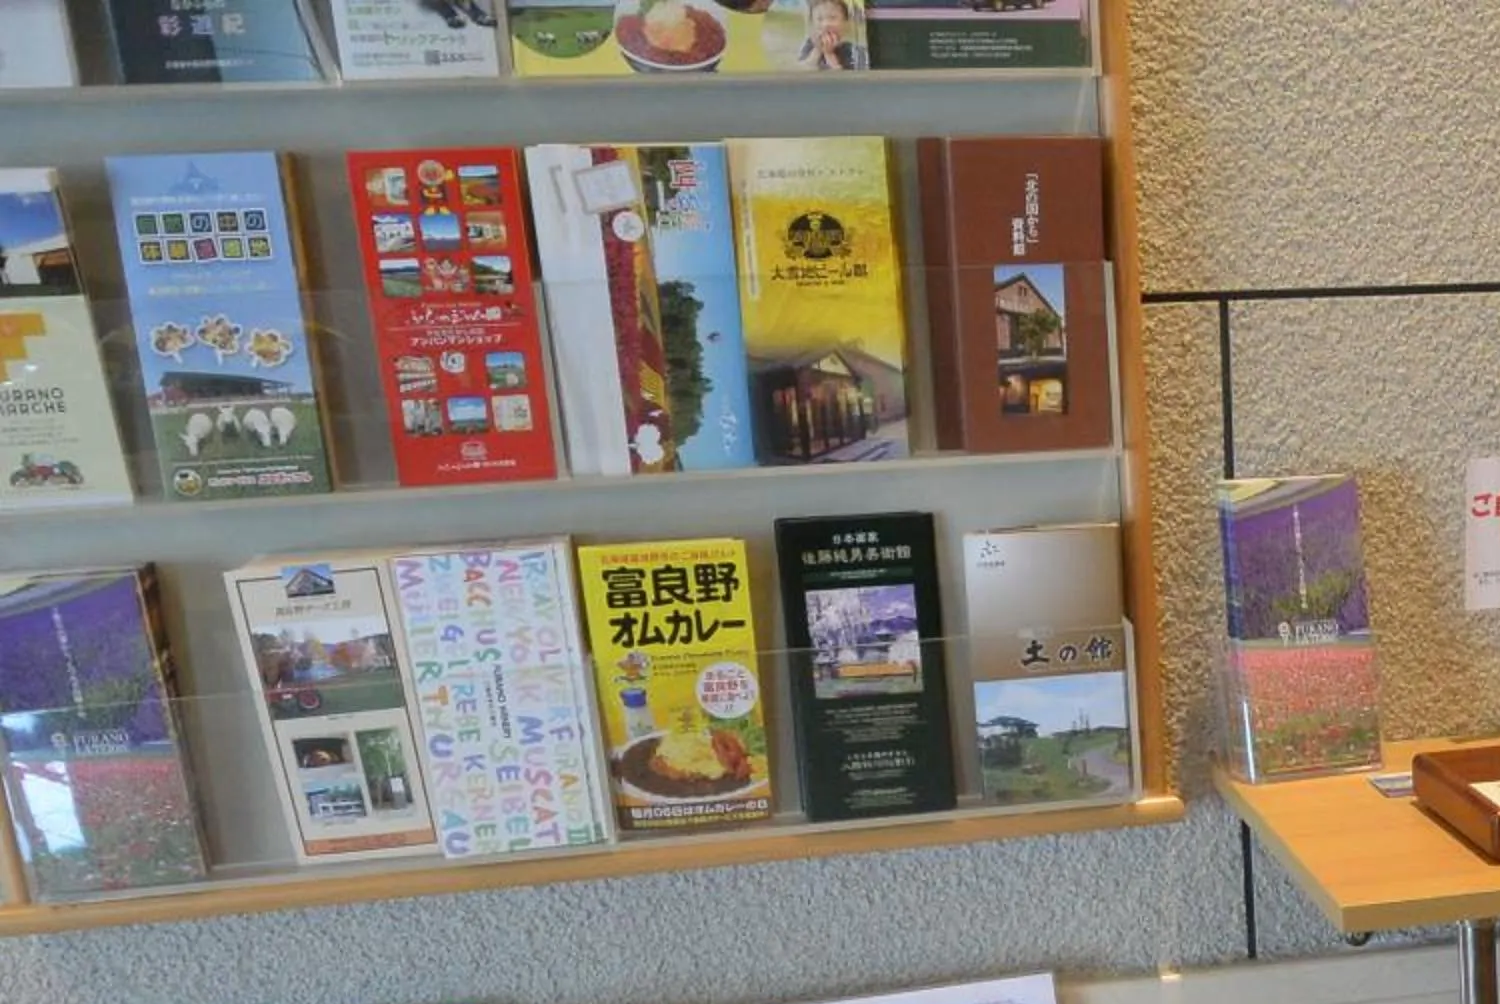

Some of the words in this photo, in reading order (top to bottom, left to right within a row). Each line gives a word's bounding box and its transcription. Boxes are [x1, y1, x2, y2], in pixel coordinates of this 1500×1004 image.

[0, 386, 64, 402] URANO
[602, 562, 740, 609] 富良野
[459, 551, 503, 664] BACCHUS
[609, 610, 746, 648] オムカレー
[1020, 635, 1113, 667] 土の館
[515, 714, 563, 846] MUSCAT
